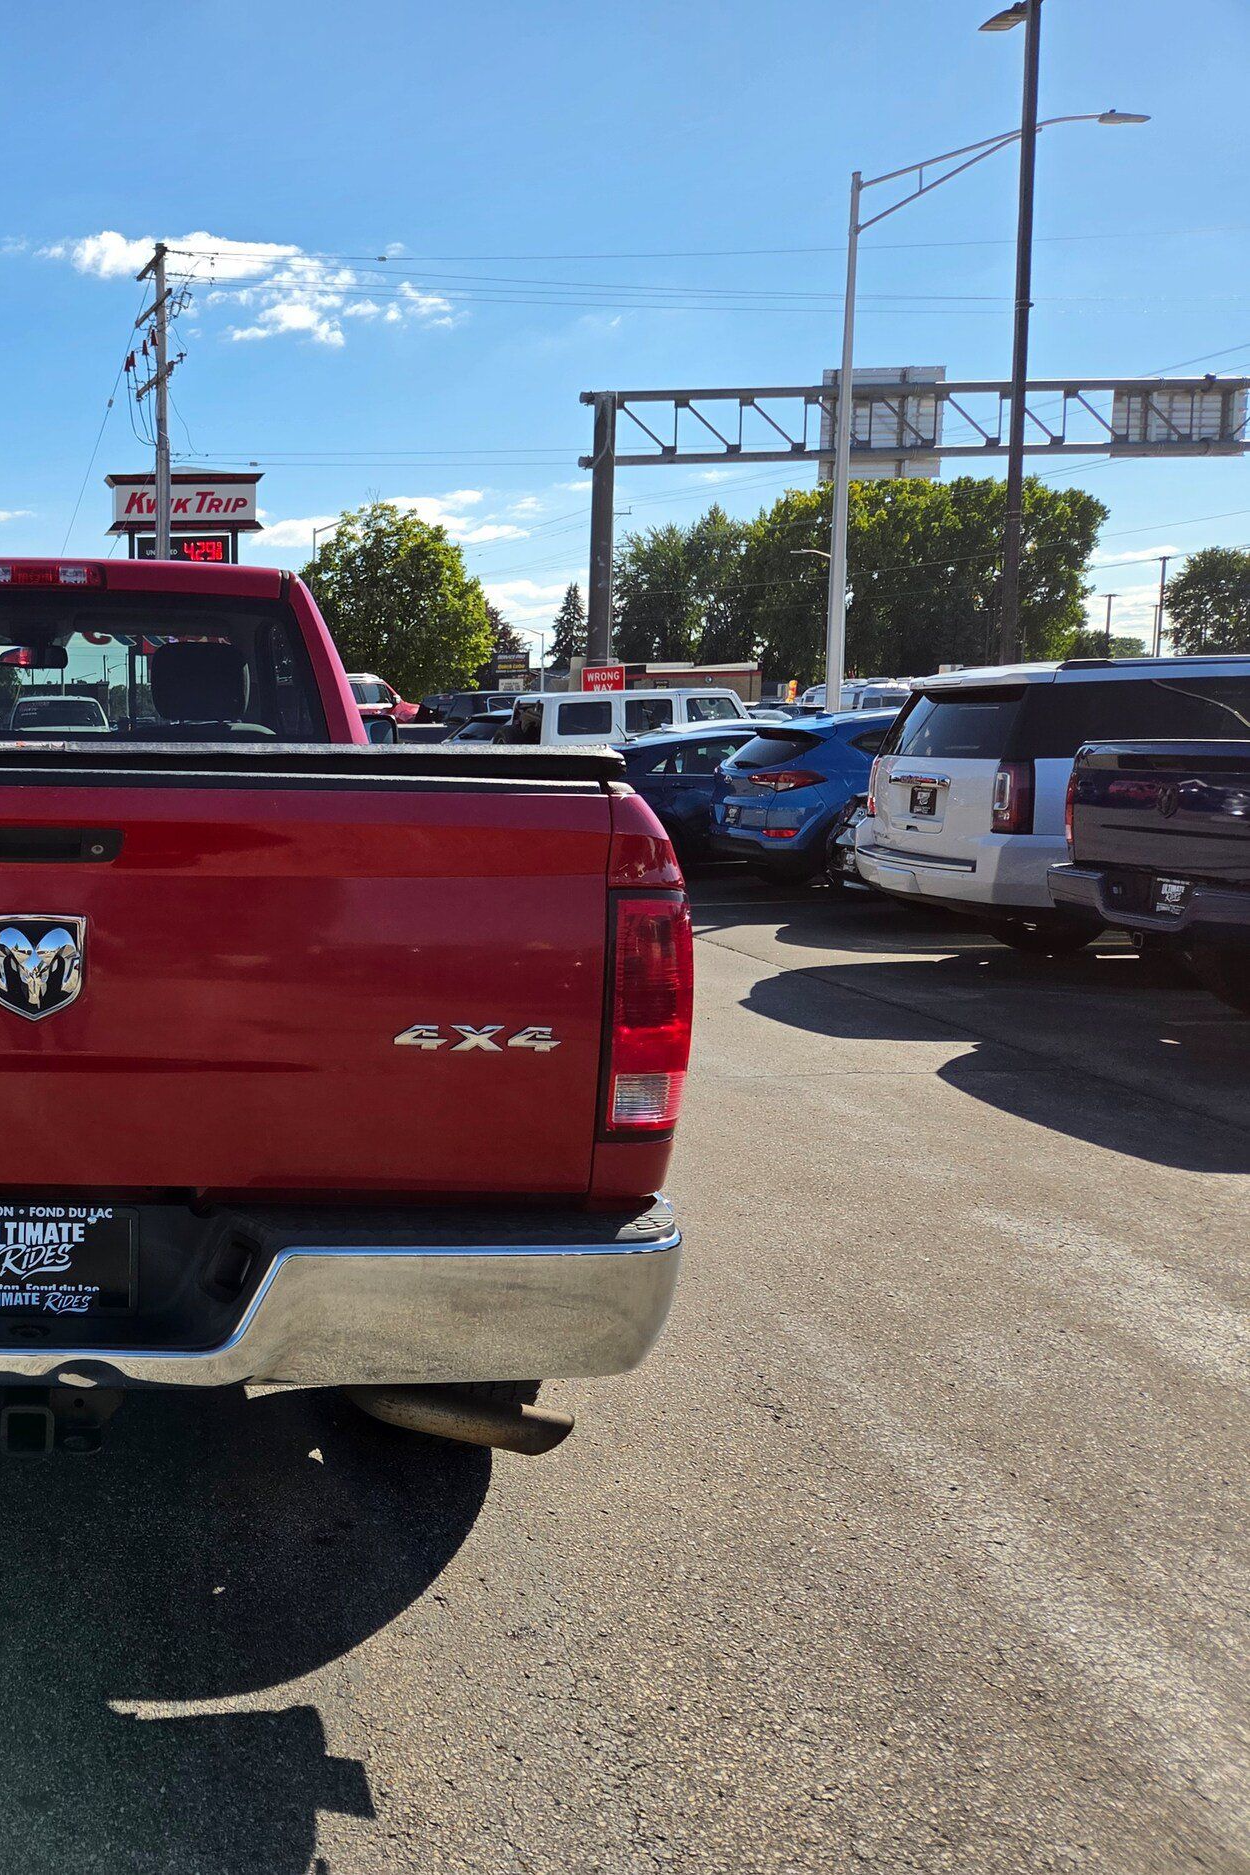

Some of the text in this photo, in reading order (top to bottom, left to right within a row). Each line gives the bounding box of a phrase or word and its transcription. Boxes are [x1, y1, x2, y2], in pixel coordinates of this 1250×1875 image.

[195, 491, 248, 514] TRIP
[586, 670, 620, 682] WRONG
[592, 683, 614, 692] WAY
[29, 1206, 65, 1218] FOND
[68, 1207, 87, 1219] DU
[90, 1207, 113, 1219] LAC
